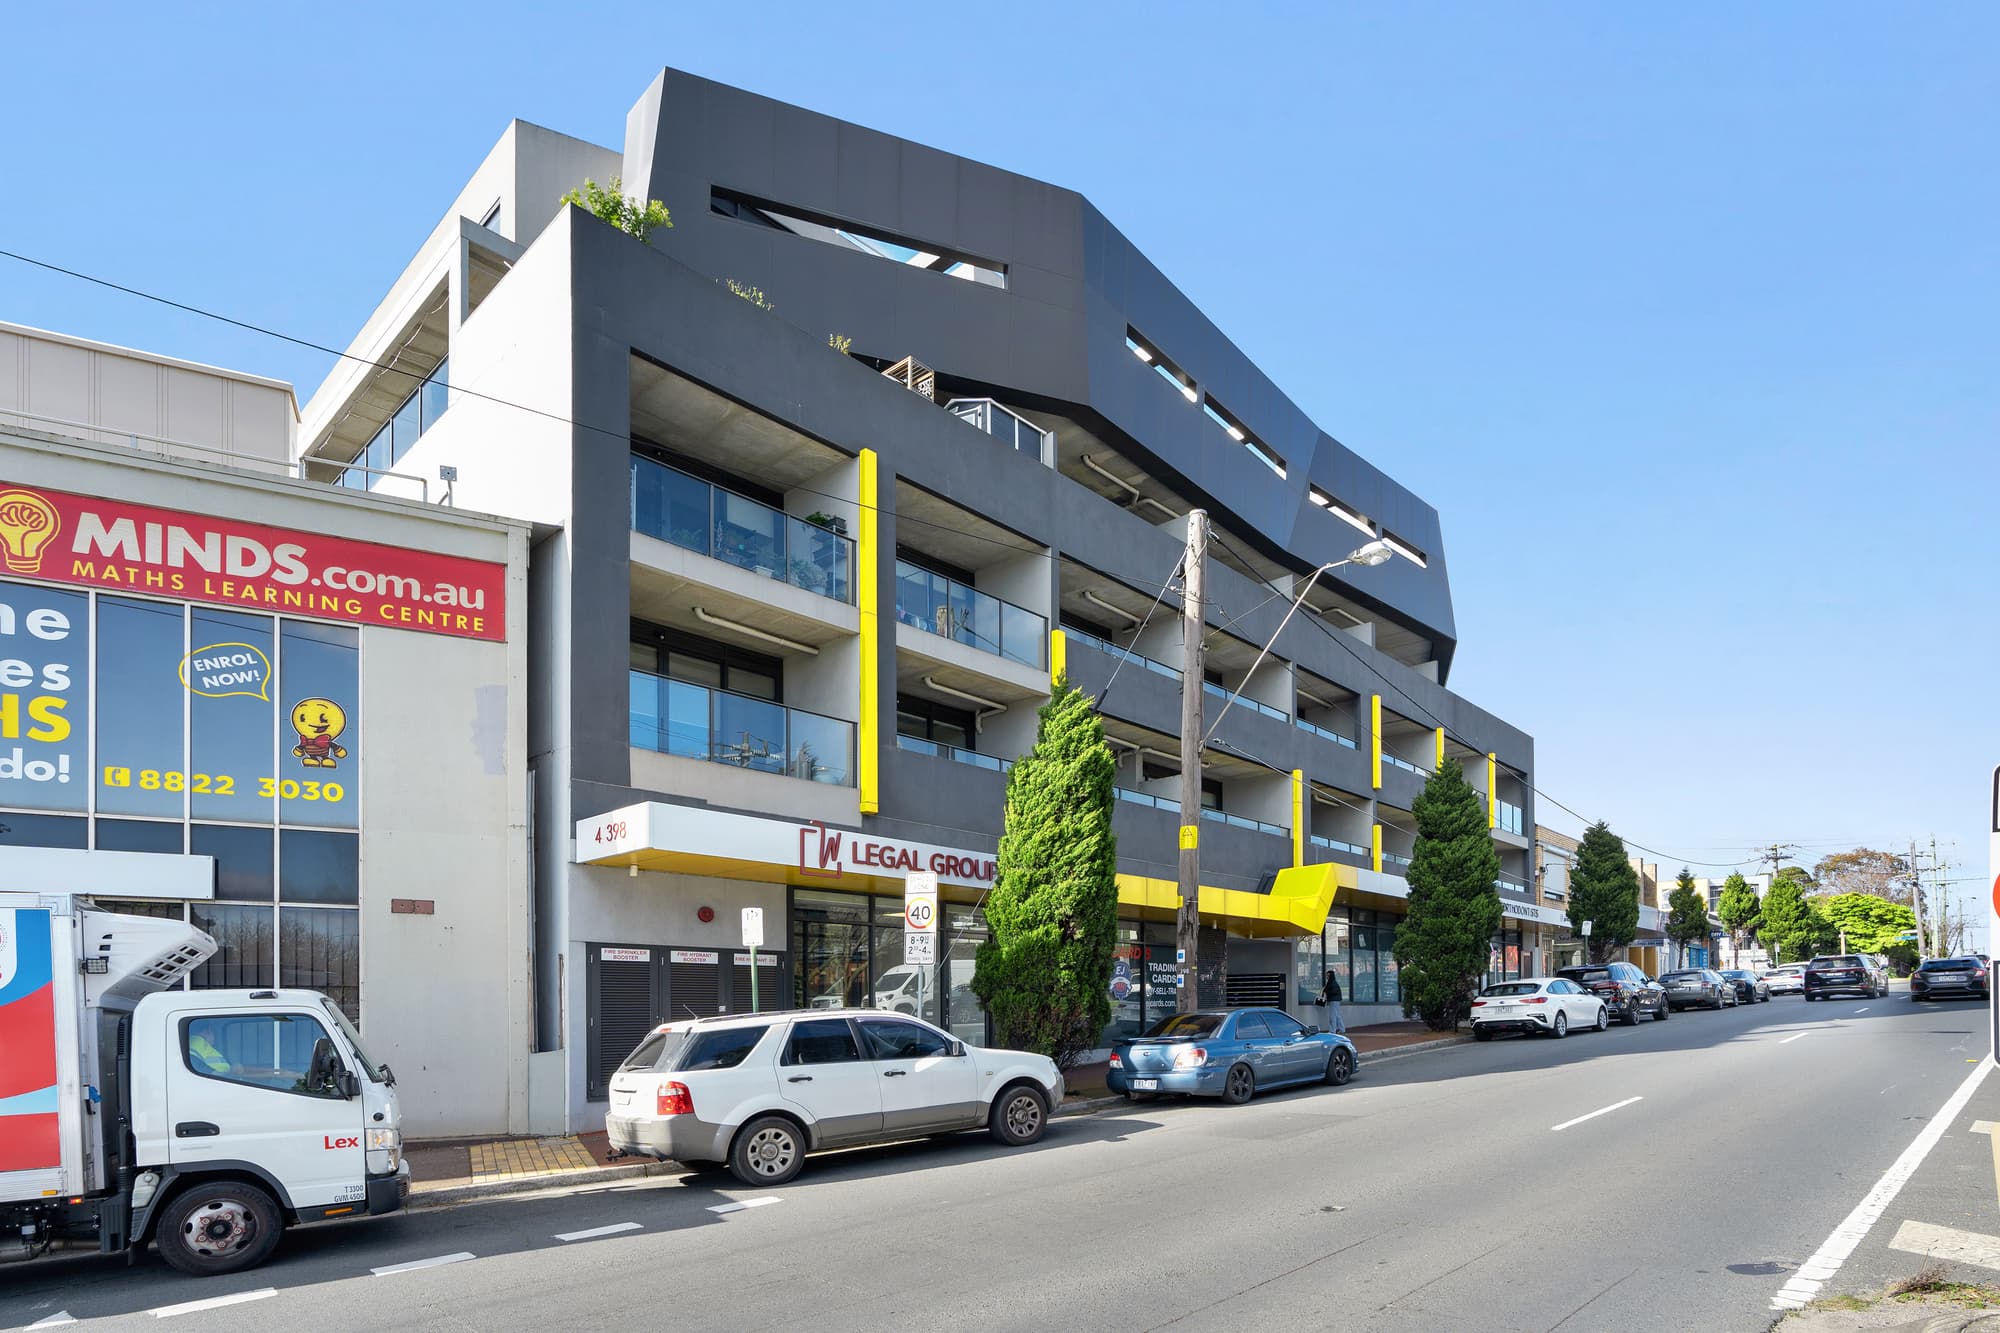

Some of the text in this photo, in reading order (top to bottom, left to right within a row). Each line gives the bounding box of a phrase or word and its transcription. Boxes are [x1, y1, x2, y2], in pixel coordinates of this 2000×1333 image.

[72, 511, 484, 610] MINDS.com.au
[72, 560, 484, 632] MATHS LEARNING CENTRE
[193, 652, 258, 672] ENROL
[202, 669, 261, 689] NOW!
[139, 769, 344, 802] 8822 3030
[595, 820, 627, 843] 4 398
[852, 841, 925, 872] LEGAL
[911, 905, 931, 920] 40
[1152, 974, 1177, 984] CARDS
[324, 1135, 359, 1150] Lex
